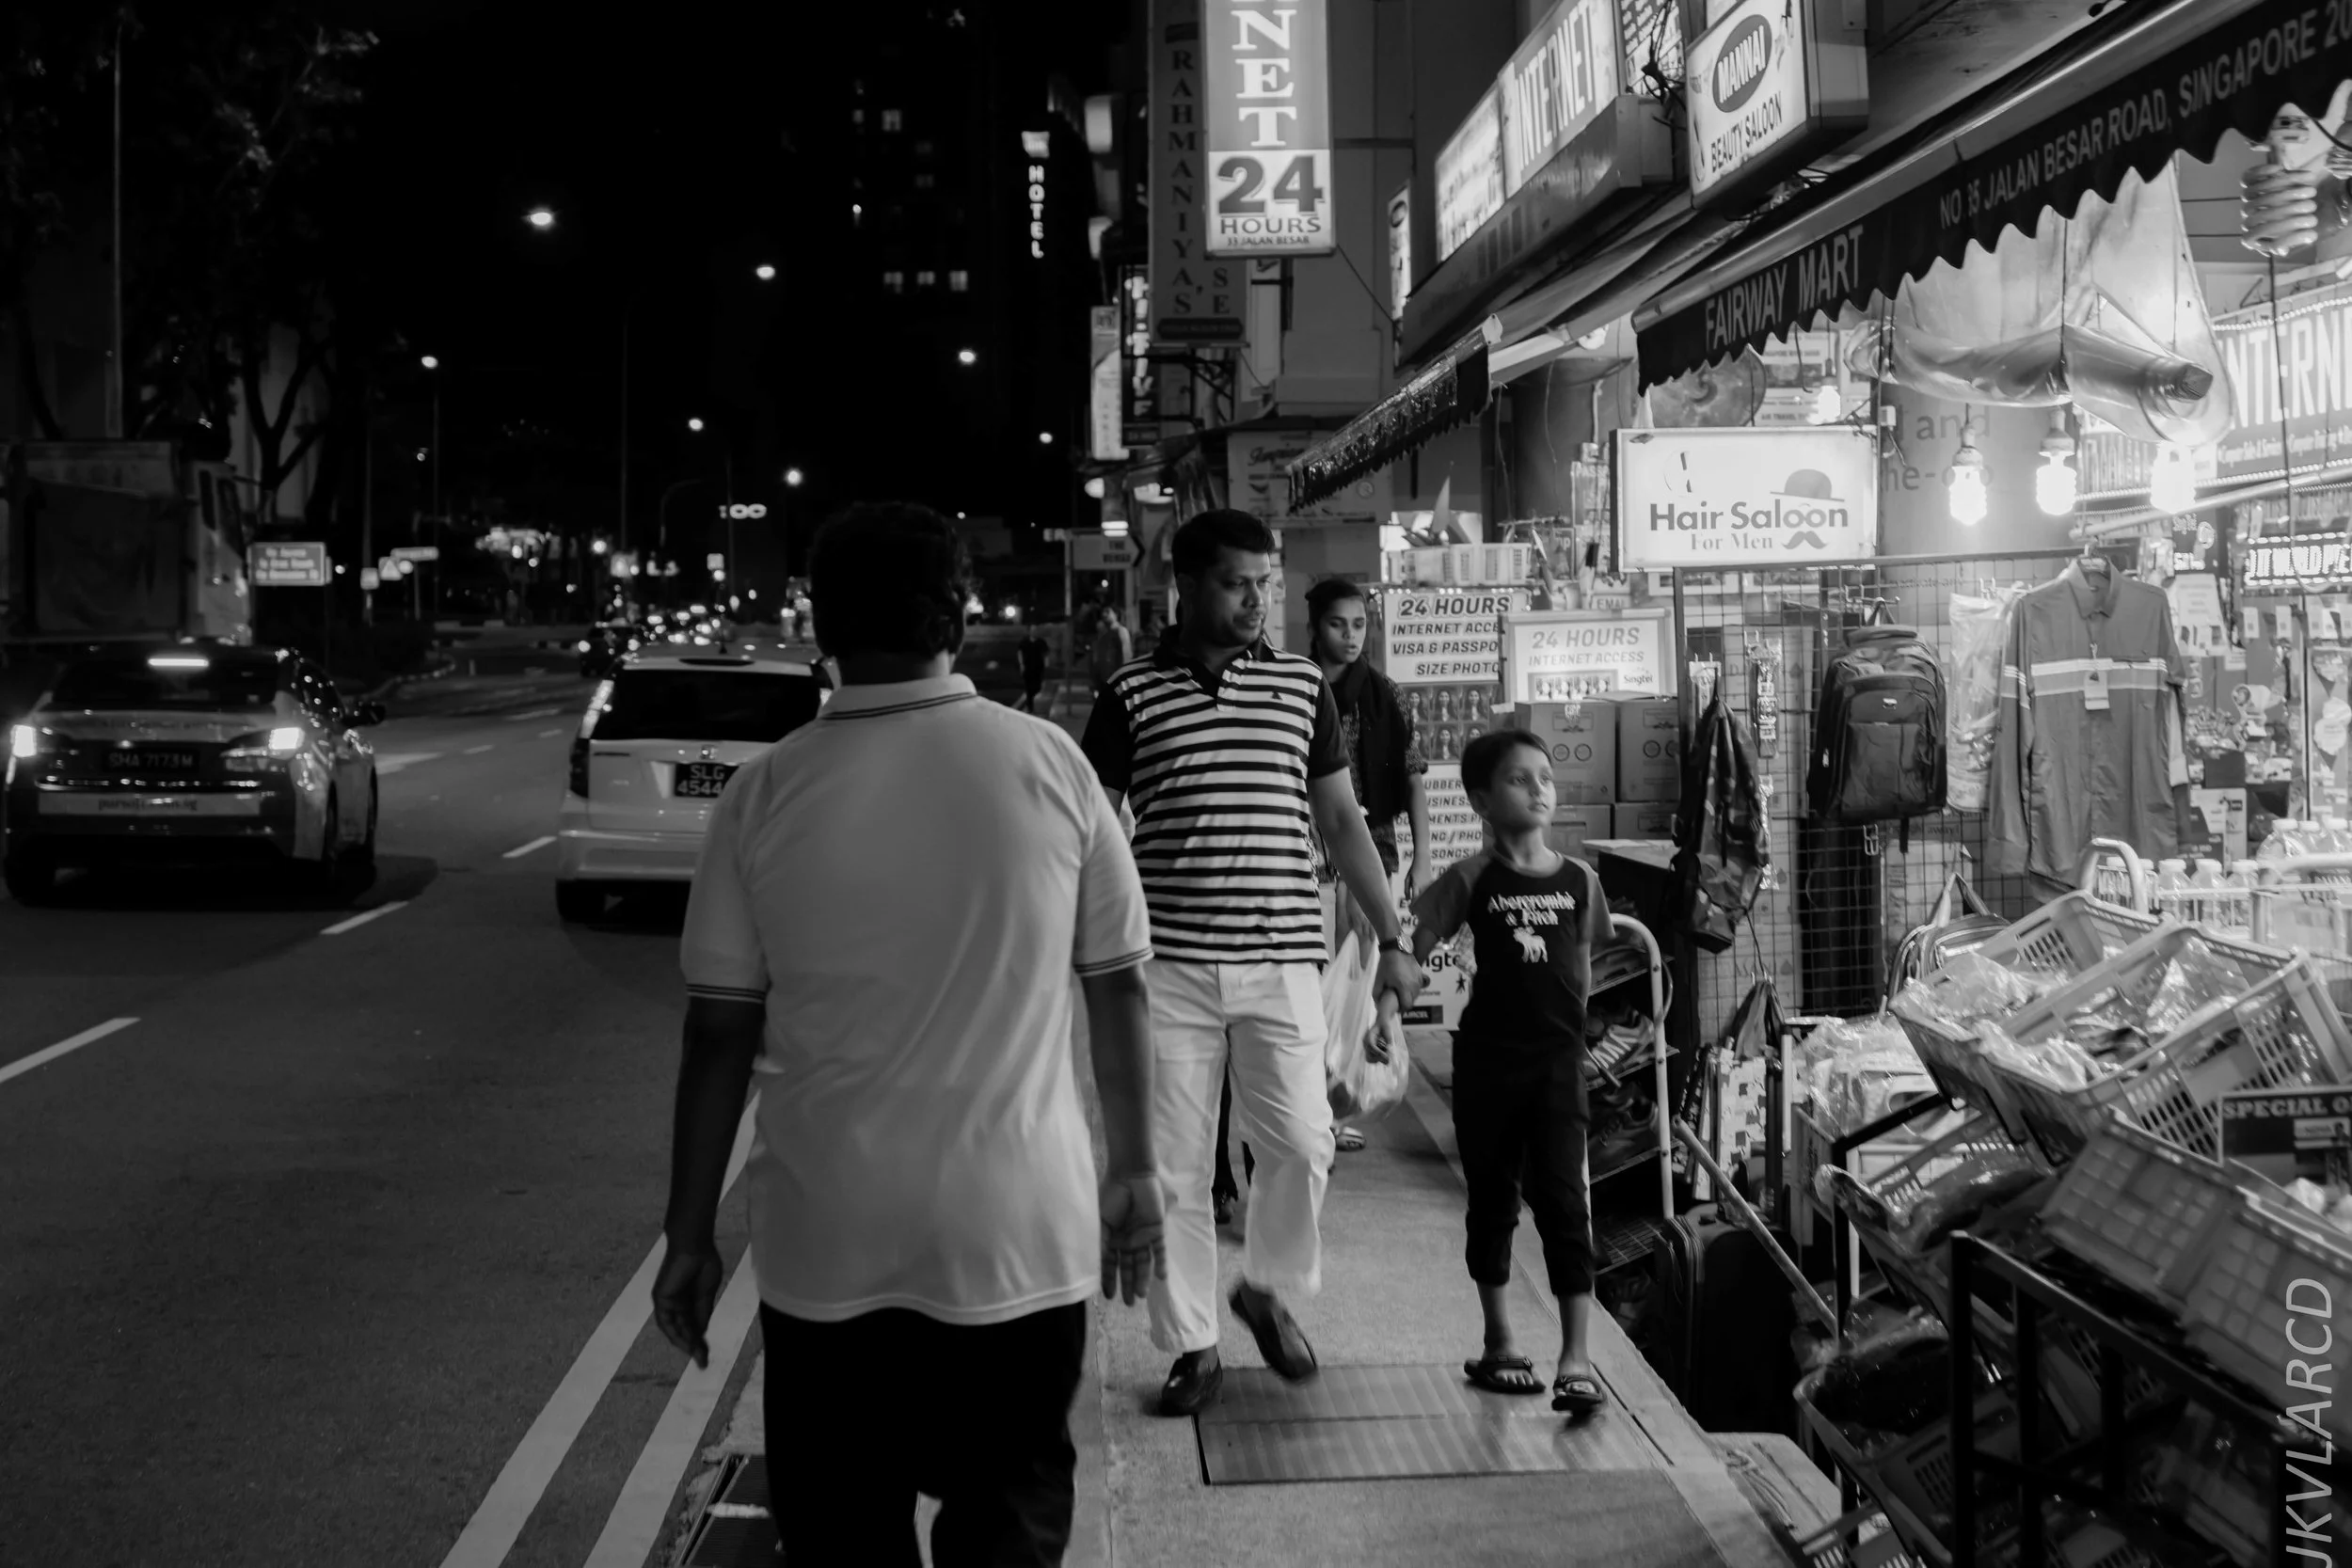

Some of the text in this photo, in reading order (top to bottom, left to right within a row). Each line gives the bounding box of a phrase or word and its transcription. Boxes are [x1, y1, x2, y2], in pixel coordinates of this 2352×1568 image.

[1717, 24, 1766, 103] MANNAI
[1515, 0, 1593, 170] INTERNET
[1984, 150, 2040, 211] JALAN
[2043, 117, 2104, 182] BESAR
[2179, 8, 2317, 119] SINGAPORE
[1711, 91, 1783, 173] BEAUTY SALOON
[1216, 154, 1326, 216] 24
[1028, 165, 1044, 259] HOTEL
[1220, 216, 1322, 235] HOURS
[1240, 237, 1272, 245] JALAN
[1705, 224, 1864, 353] FAIRWAY MART
[2217, 306, 2352, 430] NTERN
[1916, 405, 1991, 440] and
[1650, 499, 1849, 531] Hair Saloon
[1692, 532, 1773, 550] For Men
[1400, 596, 1510, 616] 24 HOURS
[1392, 623, 1462, 635] INTERNET
[1532, 627, 1640, 649] 24 HOURS
[1392, 643, 1424, 655] VISA
[1428, 642, 1438, 653] &
[1529, 651, 1645, 666] INTERNET ACCESS
[1417, 663, 1448, 675] SIZE
[1624, 674, 1653, 686] Singtel
[690, 765, 724, 780] SLG
[1424, 780, 1462, 790] UBBER
[1432, 848, 1470, 859] SONGS
[2222, 1098, 2328, 1119] SPECIAL
